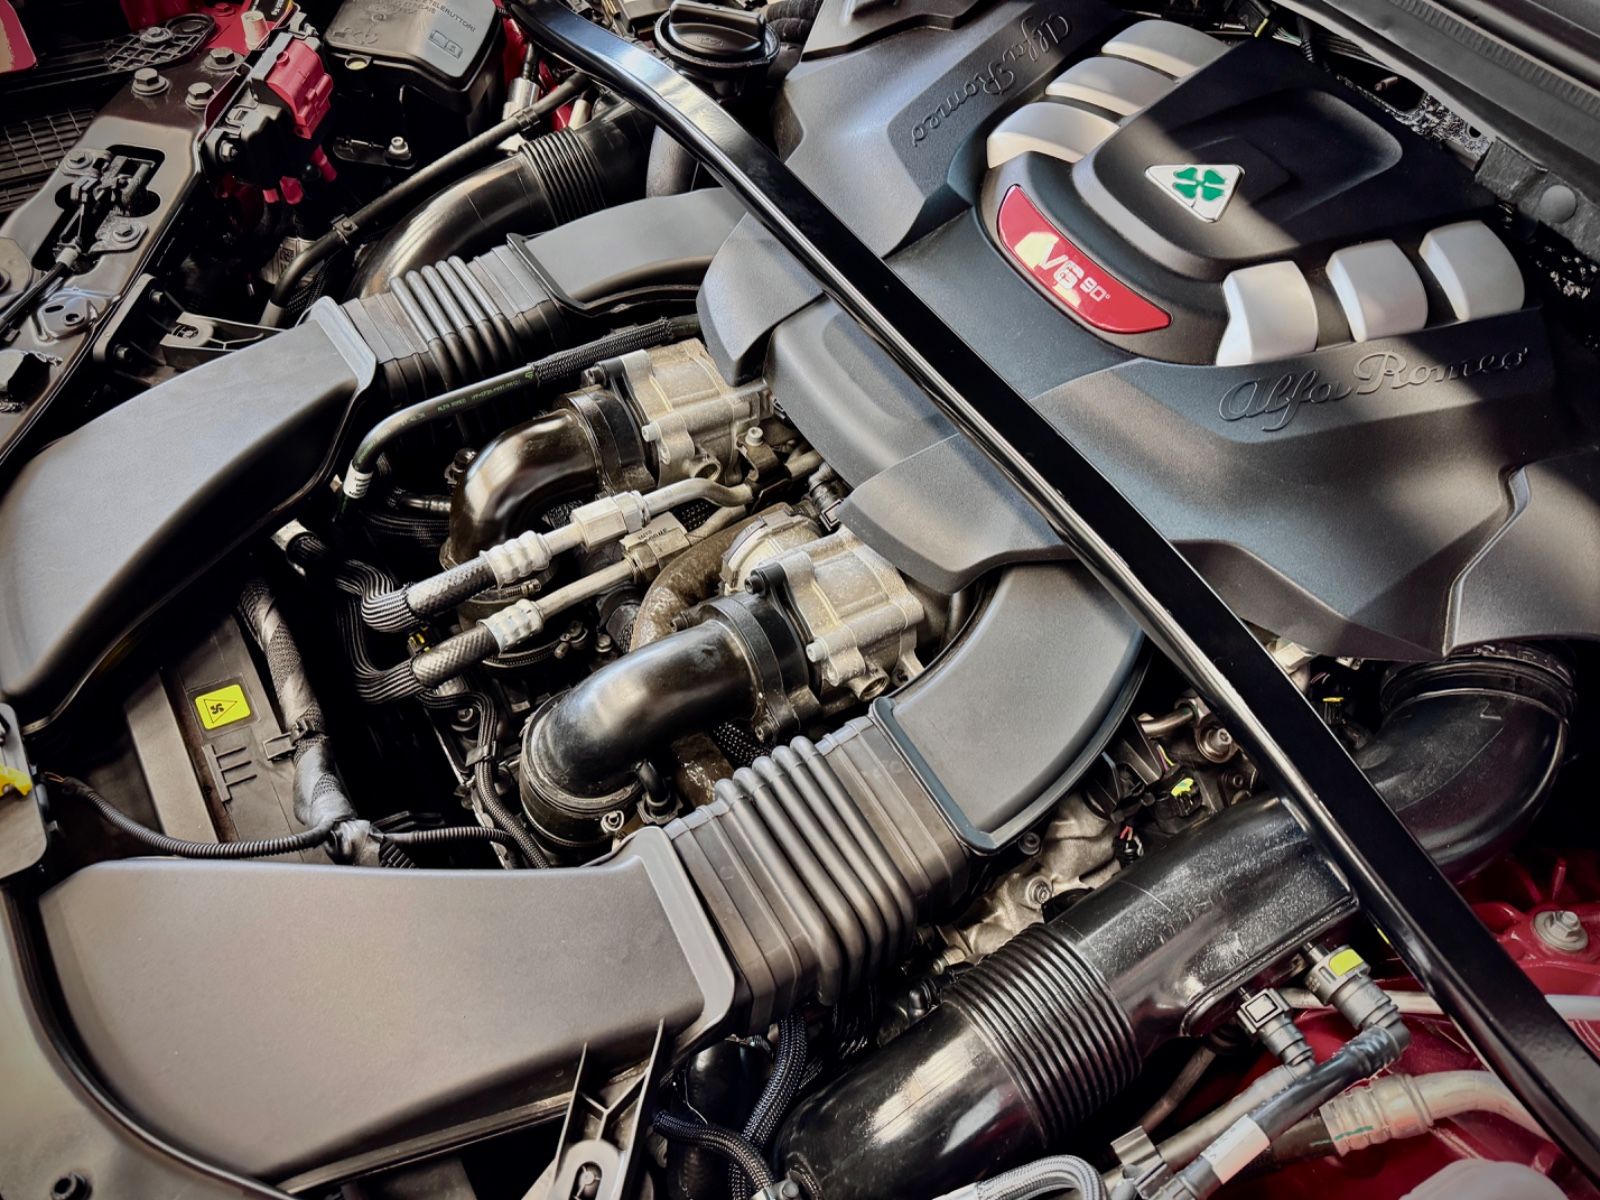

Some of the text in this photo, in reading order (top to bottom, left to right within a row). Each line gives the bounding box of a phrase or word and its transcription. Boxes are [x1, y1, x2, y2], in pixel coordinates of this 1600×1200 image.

[911, 13, 1071, 148] Alfa Romeo
[1039, 238, 1086, 290] V6
[1217, 346, 1530, 433] Alfa Romeo
